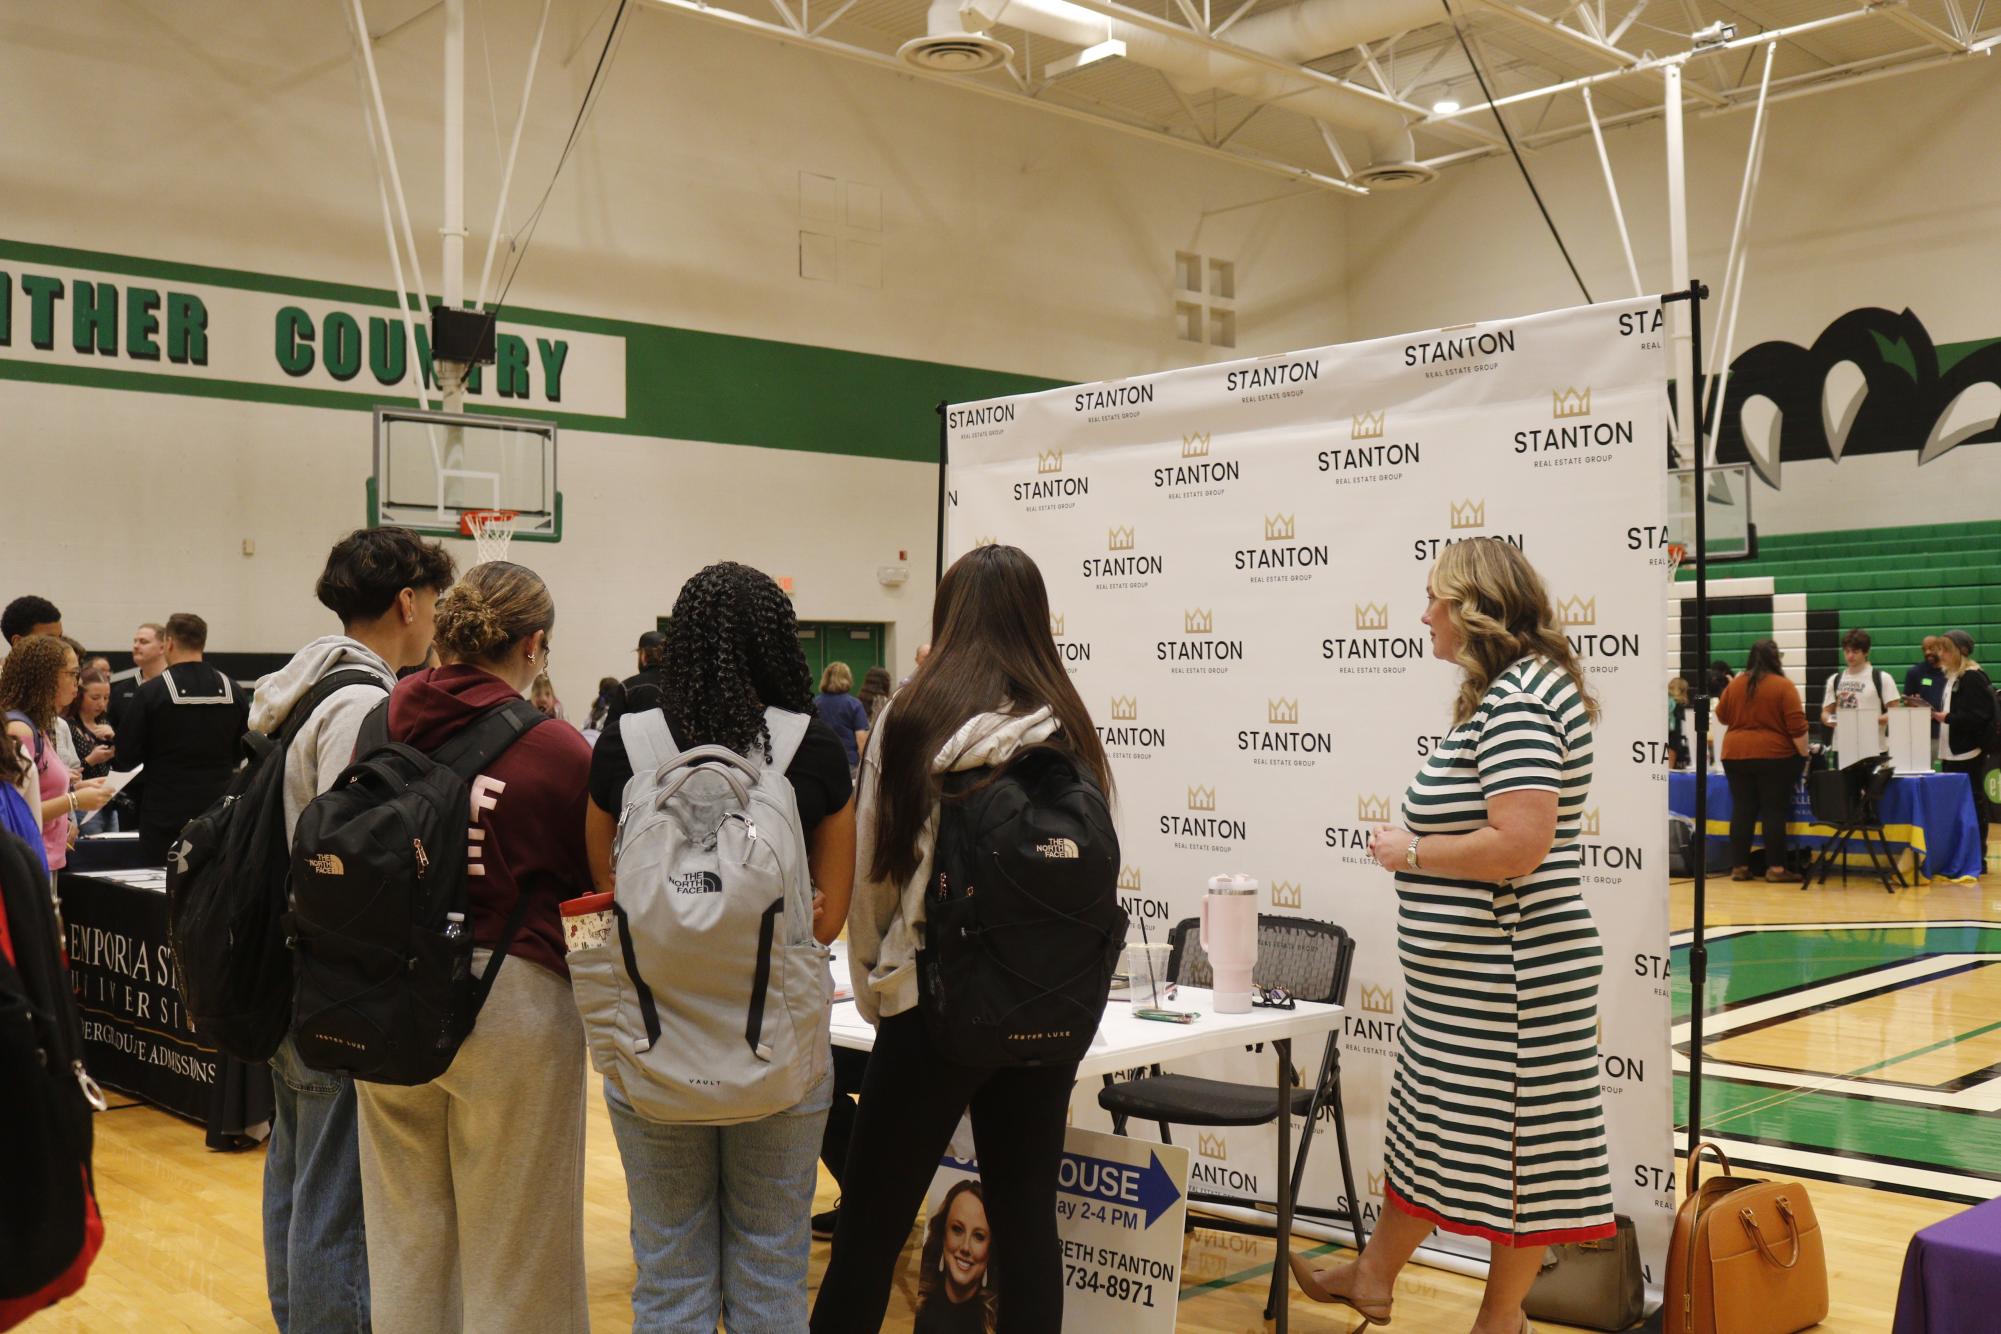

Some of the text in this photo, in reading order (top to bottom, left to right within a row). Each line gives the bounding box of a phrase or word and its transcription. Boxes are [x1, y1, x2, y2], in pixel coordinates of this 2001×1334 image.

[0, 270, 208, 366] THER
[1405, 330, 1515, 366] STANTON
[1641, 342, 1661, 350] REAL
[1227, 361, 1318, 390] STANTON
[1075, 384, 1153, 411] STANTON
[949, 404, 1015, 428] STANTON
[1515, 421, 1632, 453] STANTON
[1319, 443, 1419, 471] STANTON
[1155, 461, 1238, 487] STANTON
[1014, 477, 1088, 500] STANTON
[1083, 556, 1161, 577] STANTON
[1236, 546, 1327, 569] STANTON
[1158, 641, 1242, 660] STANTON
[1323, 638, 1422, 659] STANTON
[1590, 666, 1618, 674] GROUP
[1239, 731, 1330, 752] STANTON
[1161, 816, 1245, 840] STANTON
[1037, 844, 1064, 852] NORTH
[669, 876, 702, 887] NORTH
[683, 872, 702, 880] THE
[1654, 988, 1669, 996] REAL
[1364, 1047, 1386, 1056] ESTATE
[689, 1078, 721, 1086] VAULT
[1081, 1203, 1106, 1222] 2-4
[1112, 1208, 1138, 1230] PM
[1654, 1200, 1673, 1210] REAL
[1098, 1249, 1174, 1282] STANTON
[1066, 1264, 1154, 1308] 734-8971
